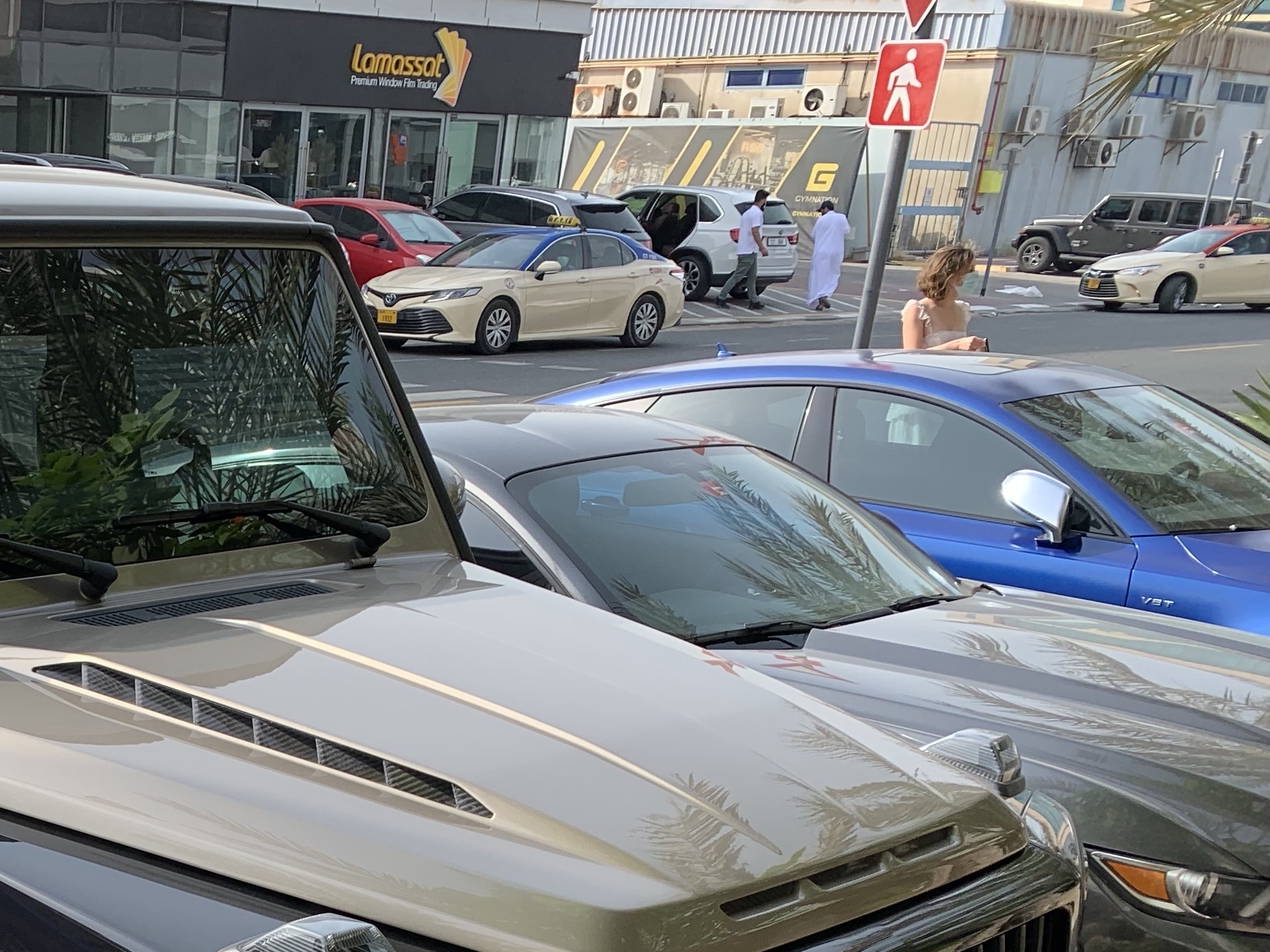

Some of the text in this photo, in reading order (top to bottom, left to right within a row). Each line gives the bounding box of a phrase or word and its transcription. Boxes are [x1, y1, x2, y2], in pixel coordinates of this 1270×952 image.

[350, 75, 438, 91] Premium Window Film Trading
[795, 195, 840, 204] GYMNATION
[791, 210, 823, 218] GYMNATIO
[1141, 596, 1175, 608] V8T
